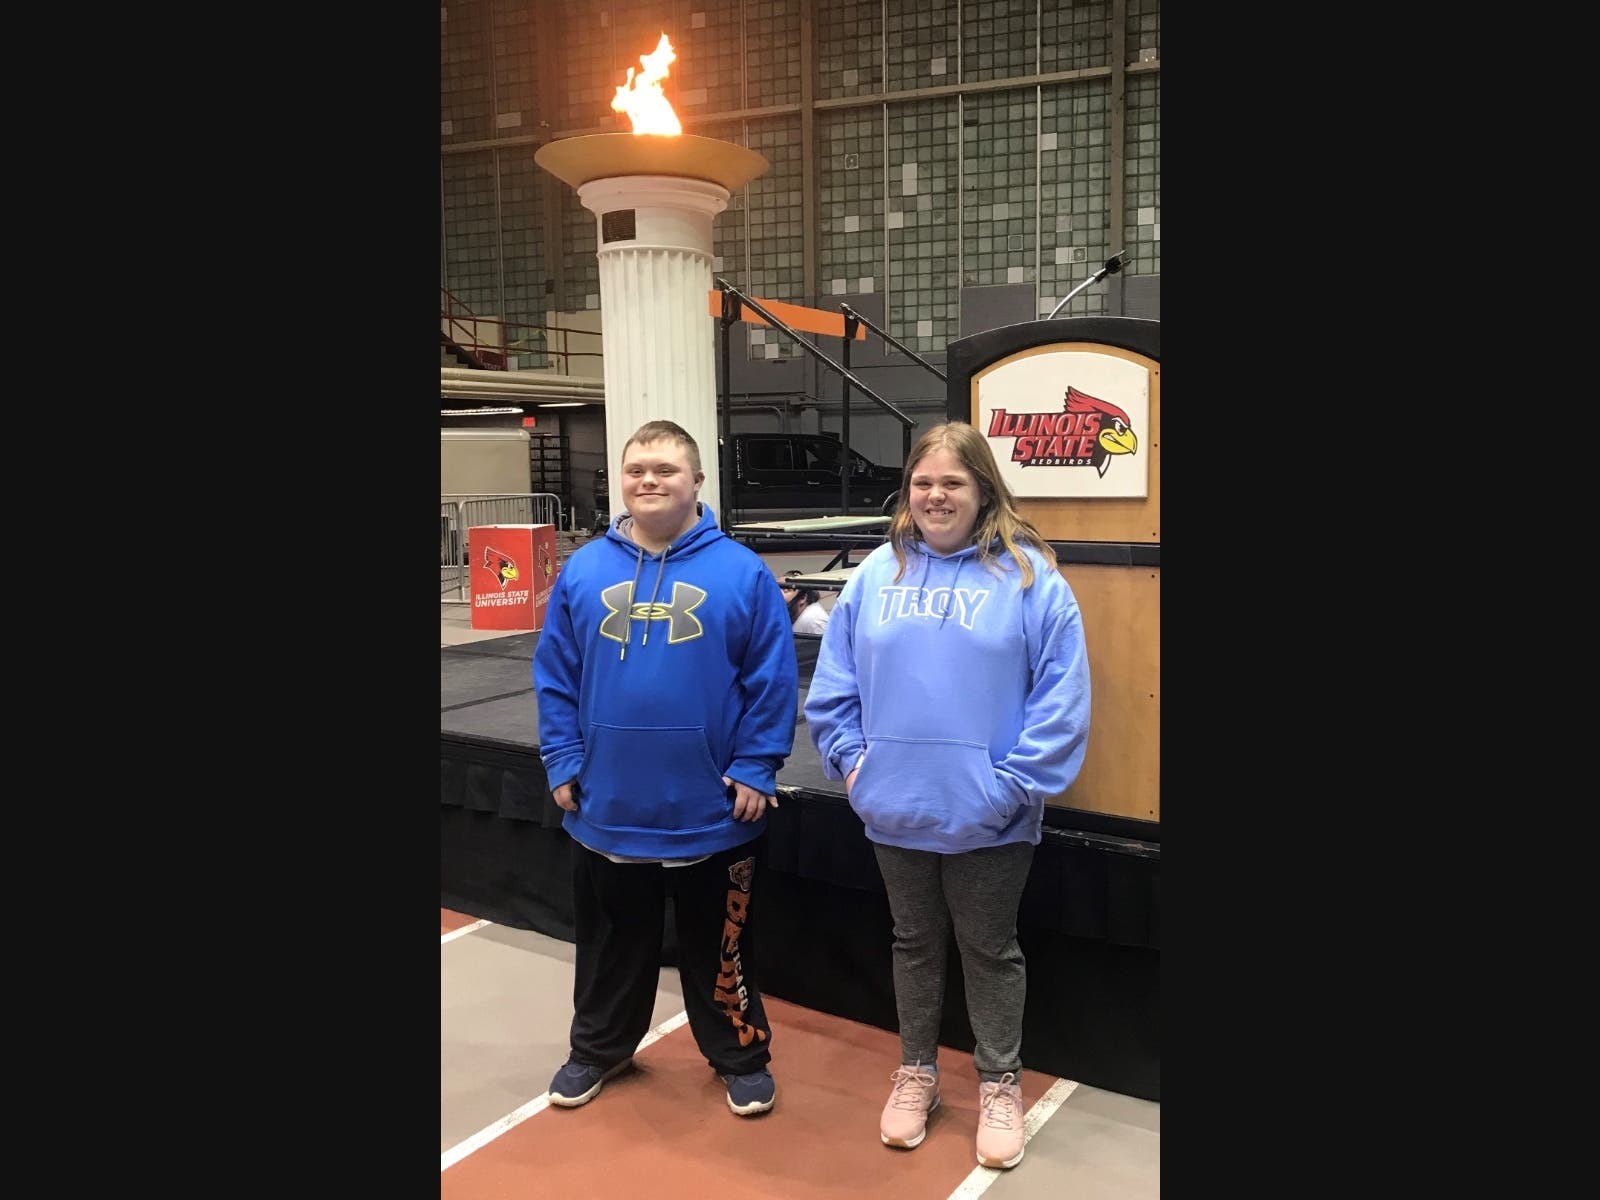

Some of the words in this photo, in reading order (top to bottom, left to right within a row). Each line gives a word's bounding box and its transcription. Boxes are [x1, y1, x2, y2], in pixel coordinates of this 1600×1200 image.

[988, 409, 1102, 437] ILLINOIS
[1012, 436, 1096, 462] STATE
[1031, 458, 1092, 466] REDBIRDS
[475, 591, 506, 600] ILLINOIS
[475, 597, 528, 607] UNIVERSITY
[879, 586, 990, 631] TROY
